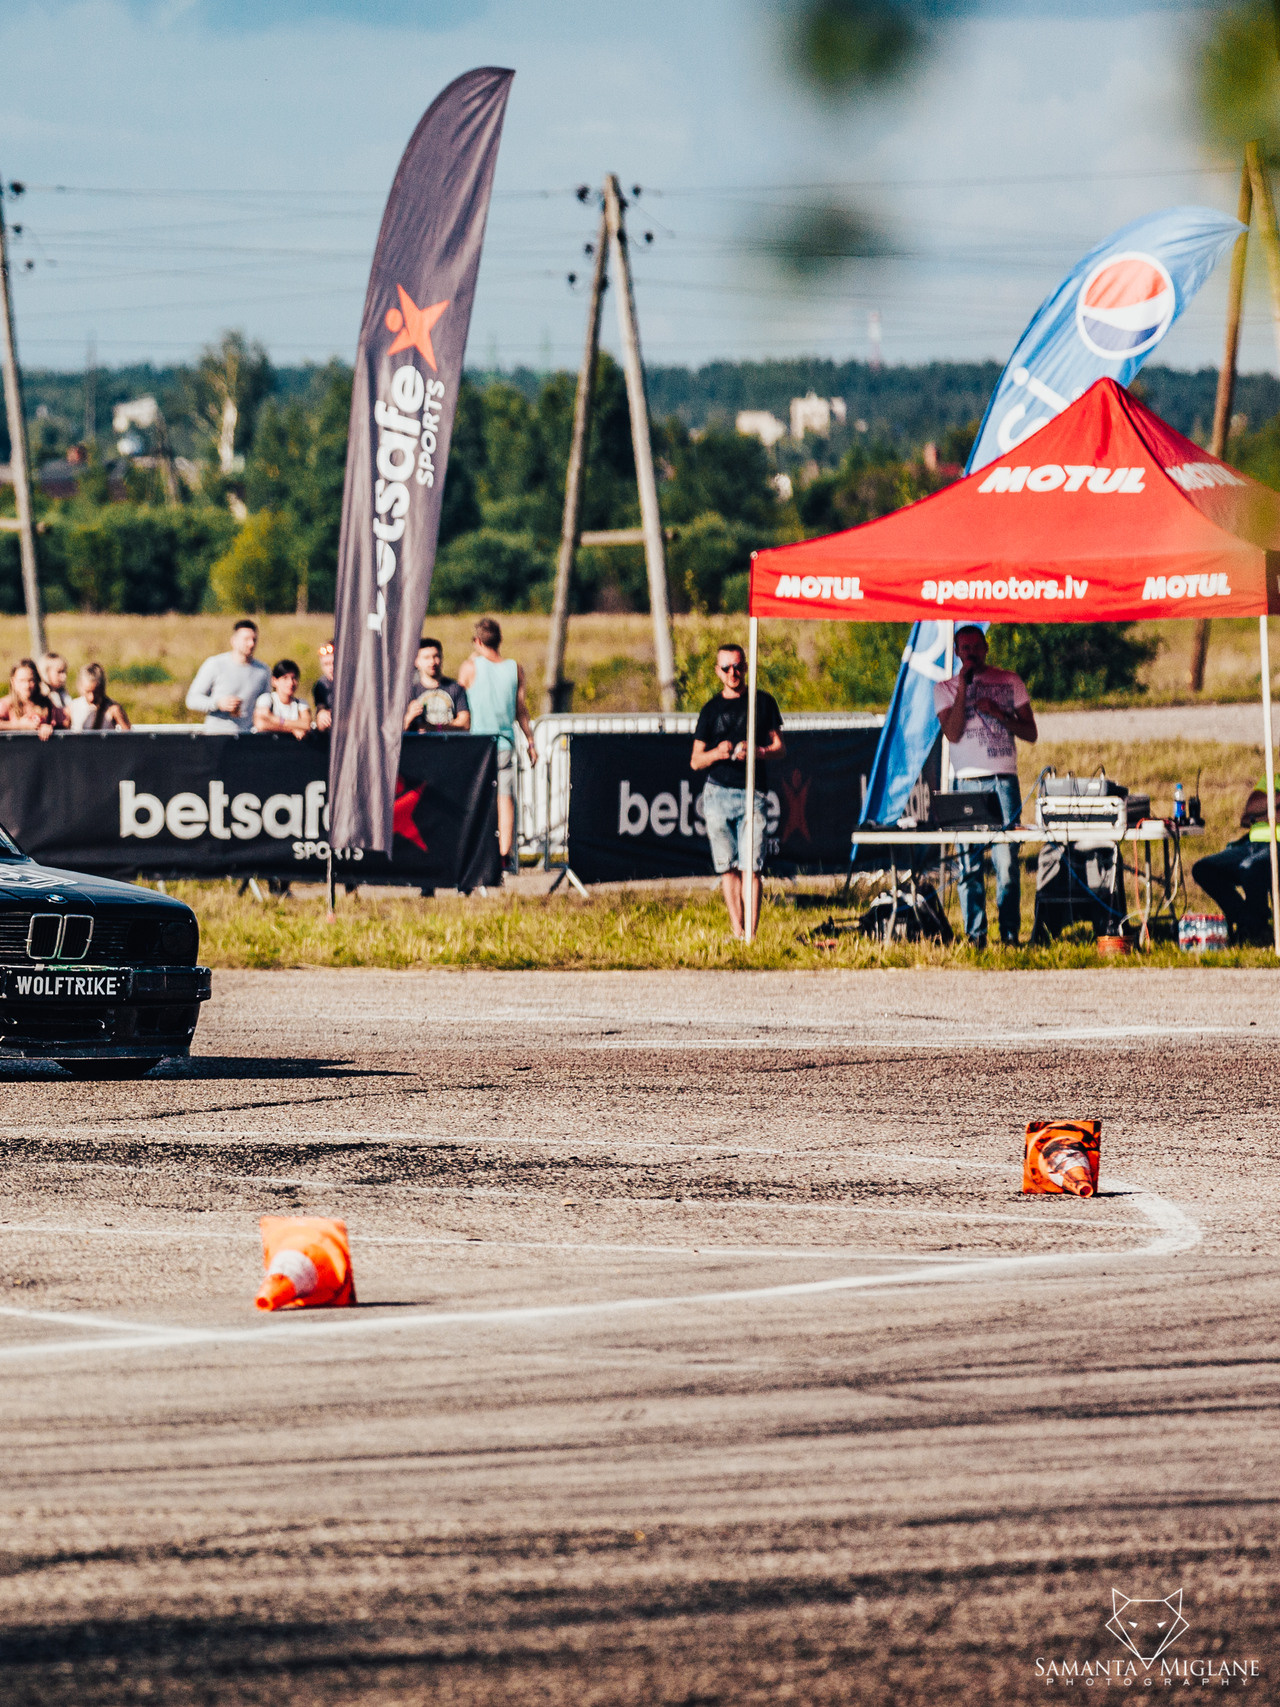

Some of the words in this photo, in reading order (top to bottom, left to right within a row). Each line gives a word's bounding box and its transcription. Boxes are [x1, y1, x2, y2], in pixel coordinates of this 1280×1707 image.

[416, 379, 446, 488] SPORTS
[977, 465, 1146, 493] MOTUL
[1165, 462, 1247, 491] MOTUL
[775, 575, 864, 600] MOTUL
[921, 575, 1089, 604] apemotors.lv
[1142, 572, 1232, 600] MOTUL
[119, 780, 330, 840] betsaf
[618, 780, 781, 837] betse
[16, 976, 117, 996] WOLFTRIKE
